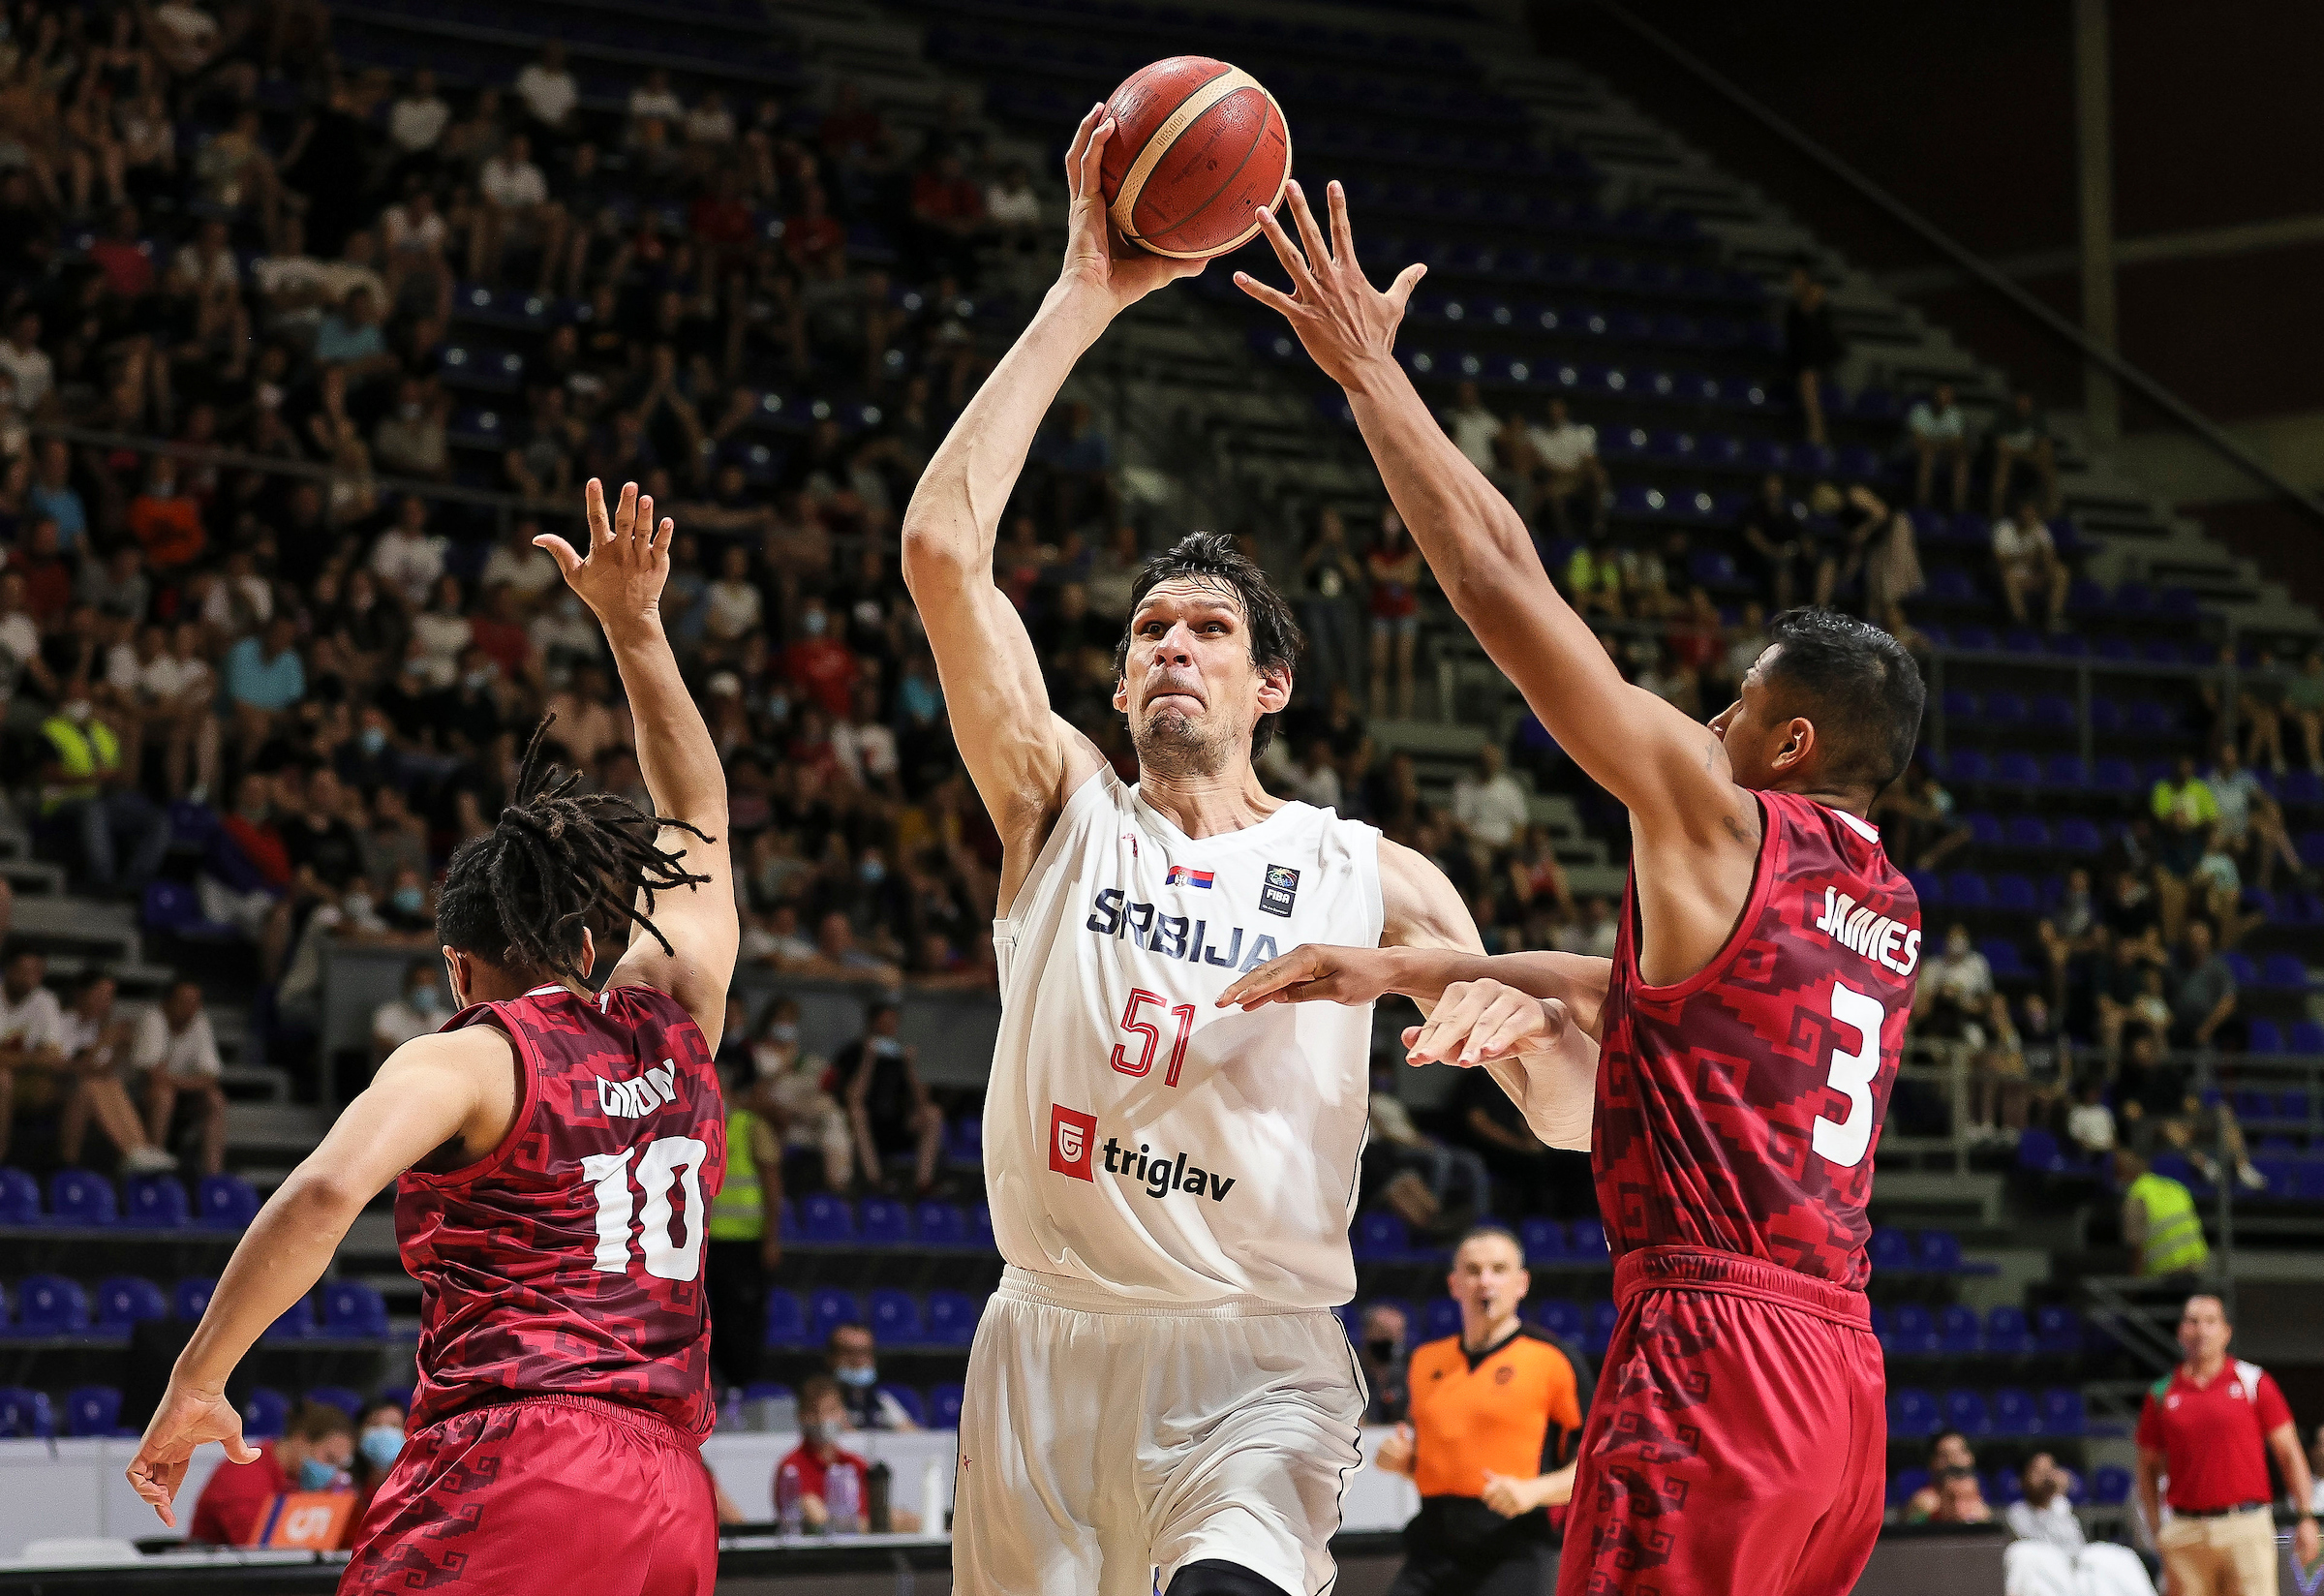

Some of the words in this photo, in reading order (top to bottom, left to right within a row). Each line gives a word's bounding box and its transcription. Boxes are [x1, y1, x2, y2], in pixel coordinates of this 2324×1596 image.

[1086, 888, 1279, 972] SRBIJA
[1267, 889, 1290, 905] FIBA
[1817, 885, 1921, 976] JAIMES
[1110, 988, 1196, 1088] 51
[1812, 980, 1885, 1168] 3
[580, 1136, 707, 1282] 10
[1102, 1137, 1236, 1203] triglav
